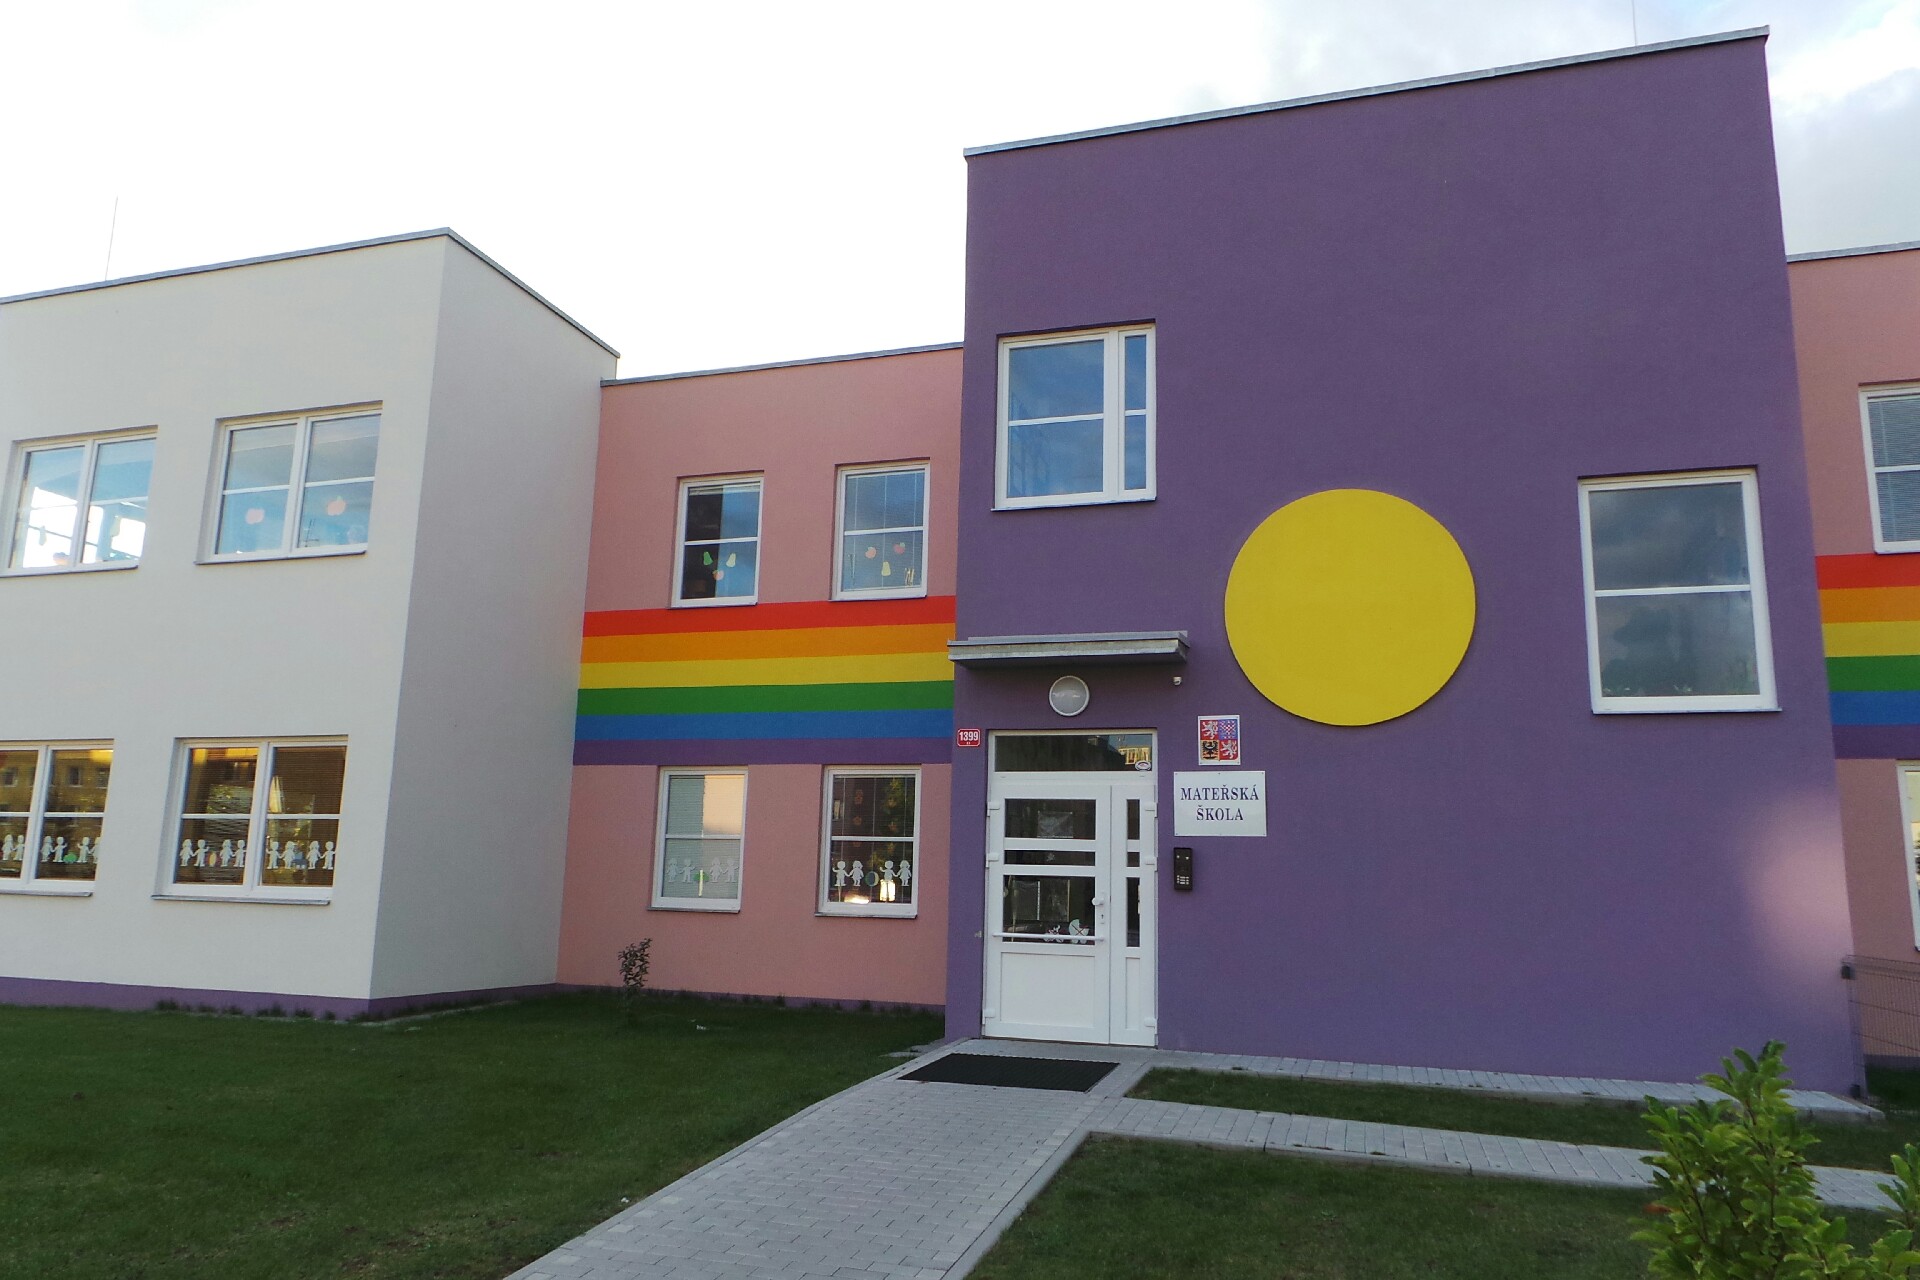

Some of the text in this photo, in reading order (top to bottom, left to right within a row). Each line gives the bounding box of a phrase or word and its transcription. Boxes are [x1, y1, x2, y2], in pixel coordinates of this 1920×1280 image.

[959, 731, 979, 741] 1399
[1180, 784, 1259, 801] MATEŘSKÁ
[1196, 804, 1244, 821] ŠKOLA
